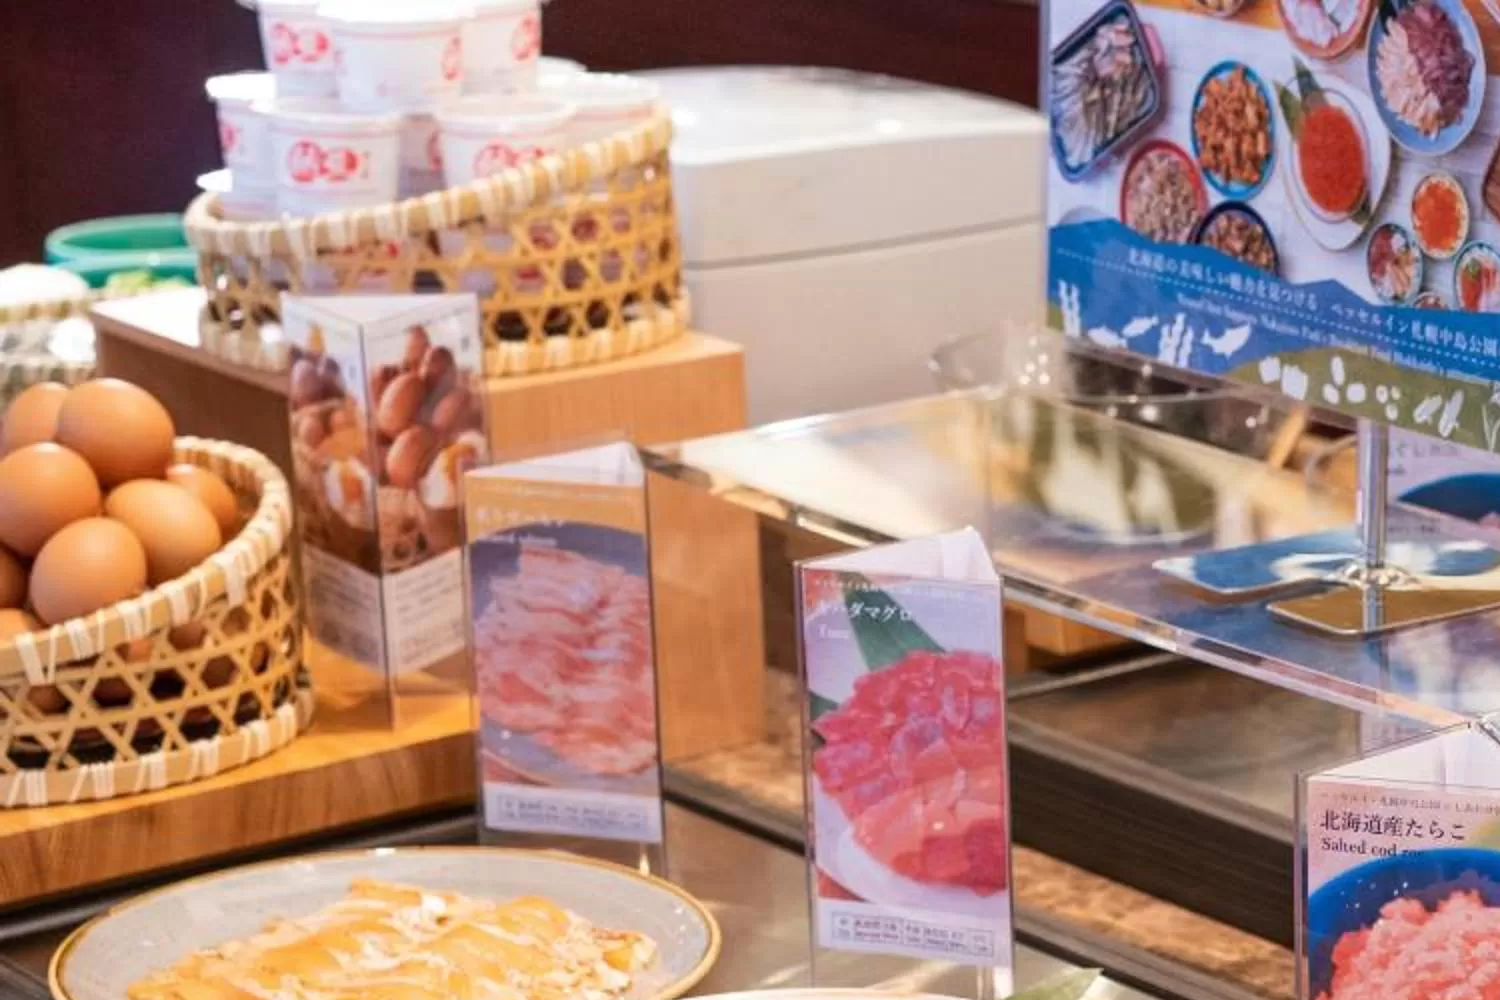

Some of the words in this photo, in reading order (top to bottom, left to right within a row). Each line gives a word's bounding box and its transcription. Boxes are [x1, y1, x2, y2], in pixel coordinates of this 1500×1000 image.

[1320, 808, 1467, 841] 北海道産たらこ
[1321, 838, 1366, 856] Salted
[1371, 844, 1397, 858] cod
